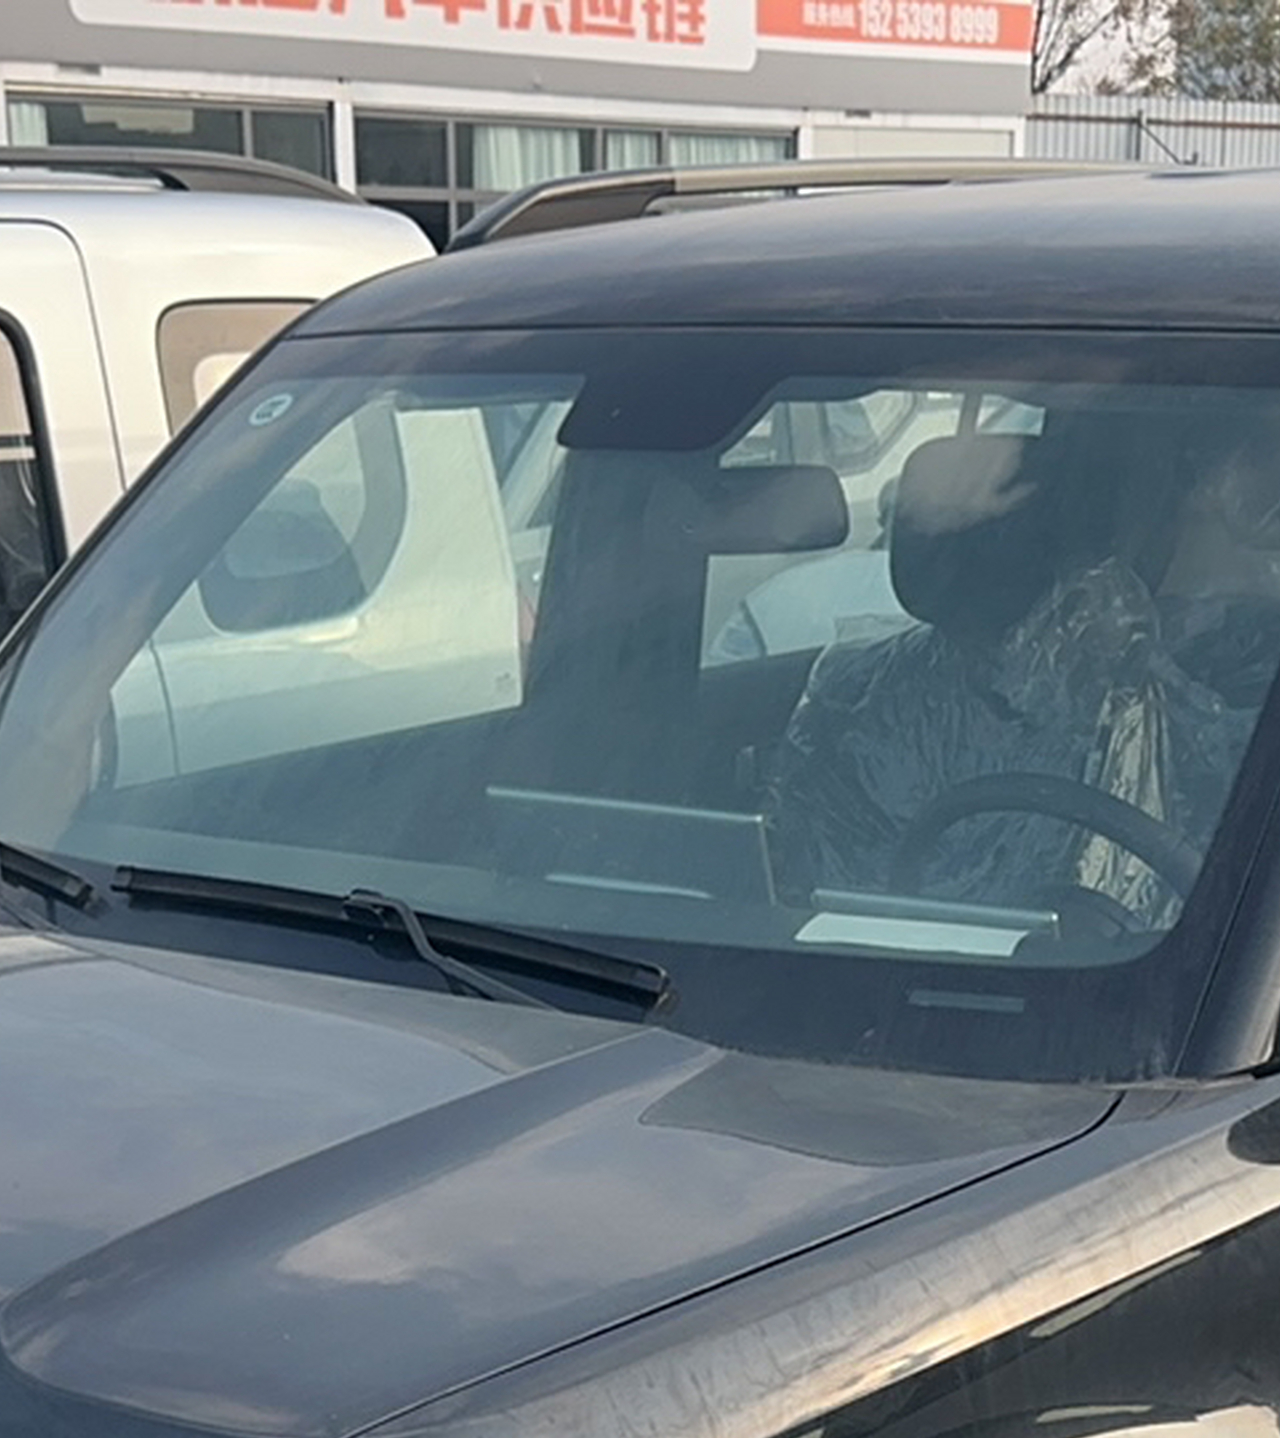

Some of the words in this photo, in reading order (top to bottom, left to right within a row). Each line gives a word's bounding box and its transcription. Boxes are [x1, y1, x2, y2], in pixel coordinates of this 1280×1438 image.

[859, 0, 892, 38] 152
[896, 2, 946, 41] 5393
[950, 5, 1000, 44] 8999
